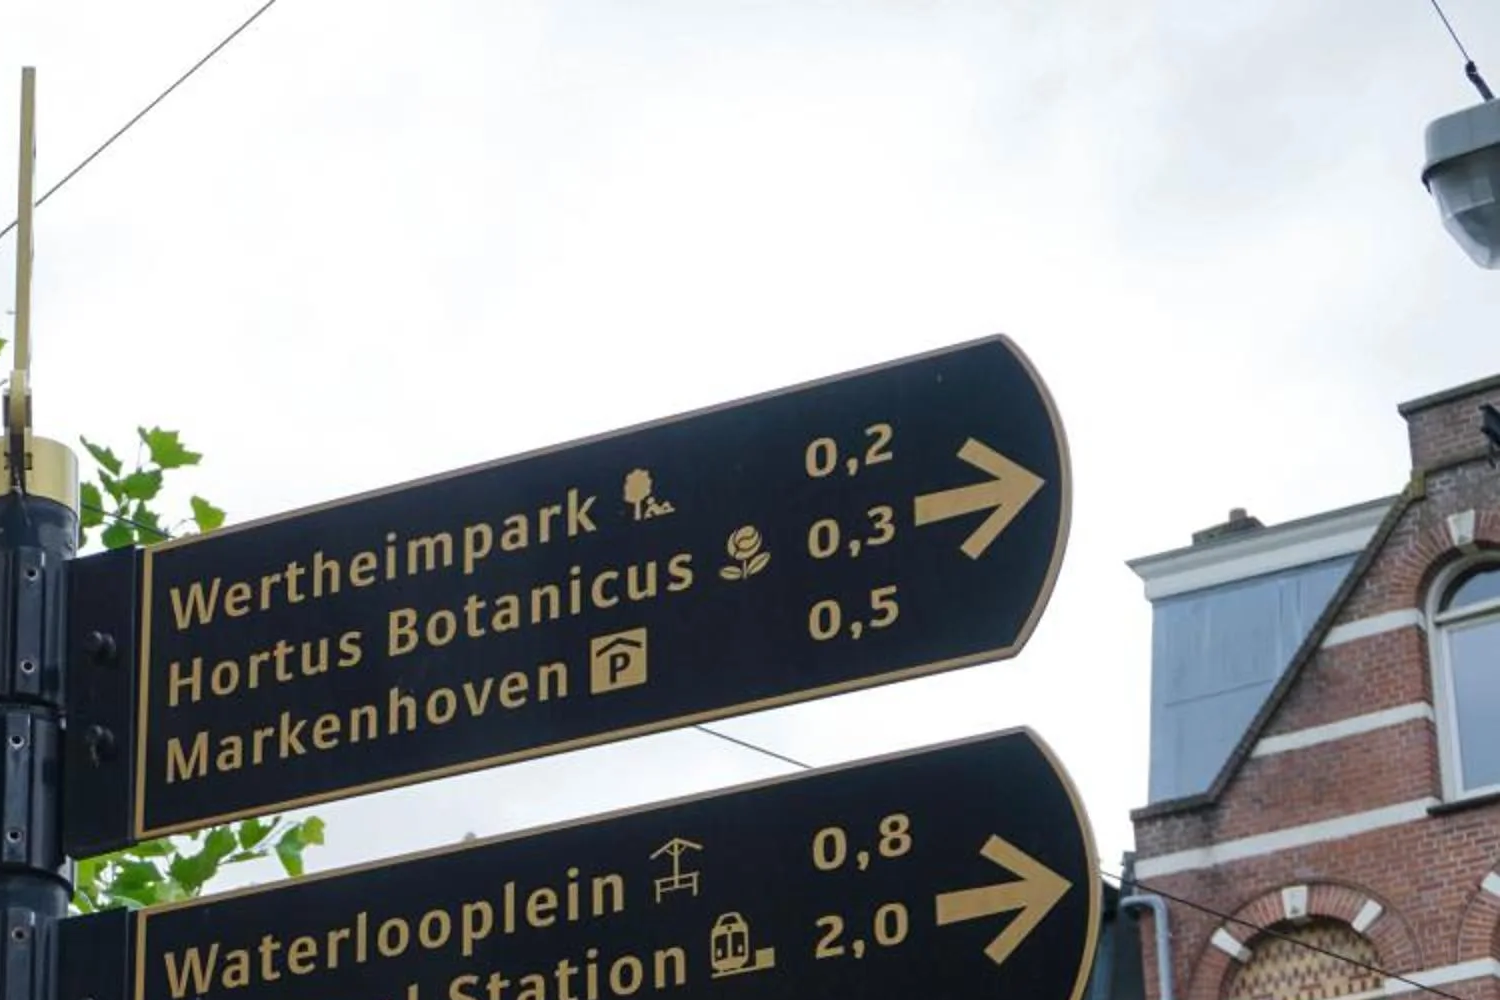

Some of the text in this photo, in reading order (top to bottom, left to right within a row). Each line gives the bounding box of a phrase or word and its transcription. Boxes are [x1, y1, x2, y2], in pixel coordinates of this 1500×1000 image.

[168, 504, 896, 708] Hortus Botanicus 0,3
[169, 422, 894, 631] Wertheimpark 0,2
[166, 661, 568, 784] Markenhoven
[808, 584, 900, 642] 0,5
[163, 812, 912, 999] Waterlooplein 0,8
[814, 902, 909, 960] 2,0
